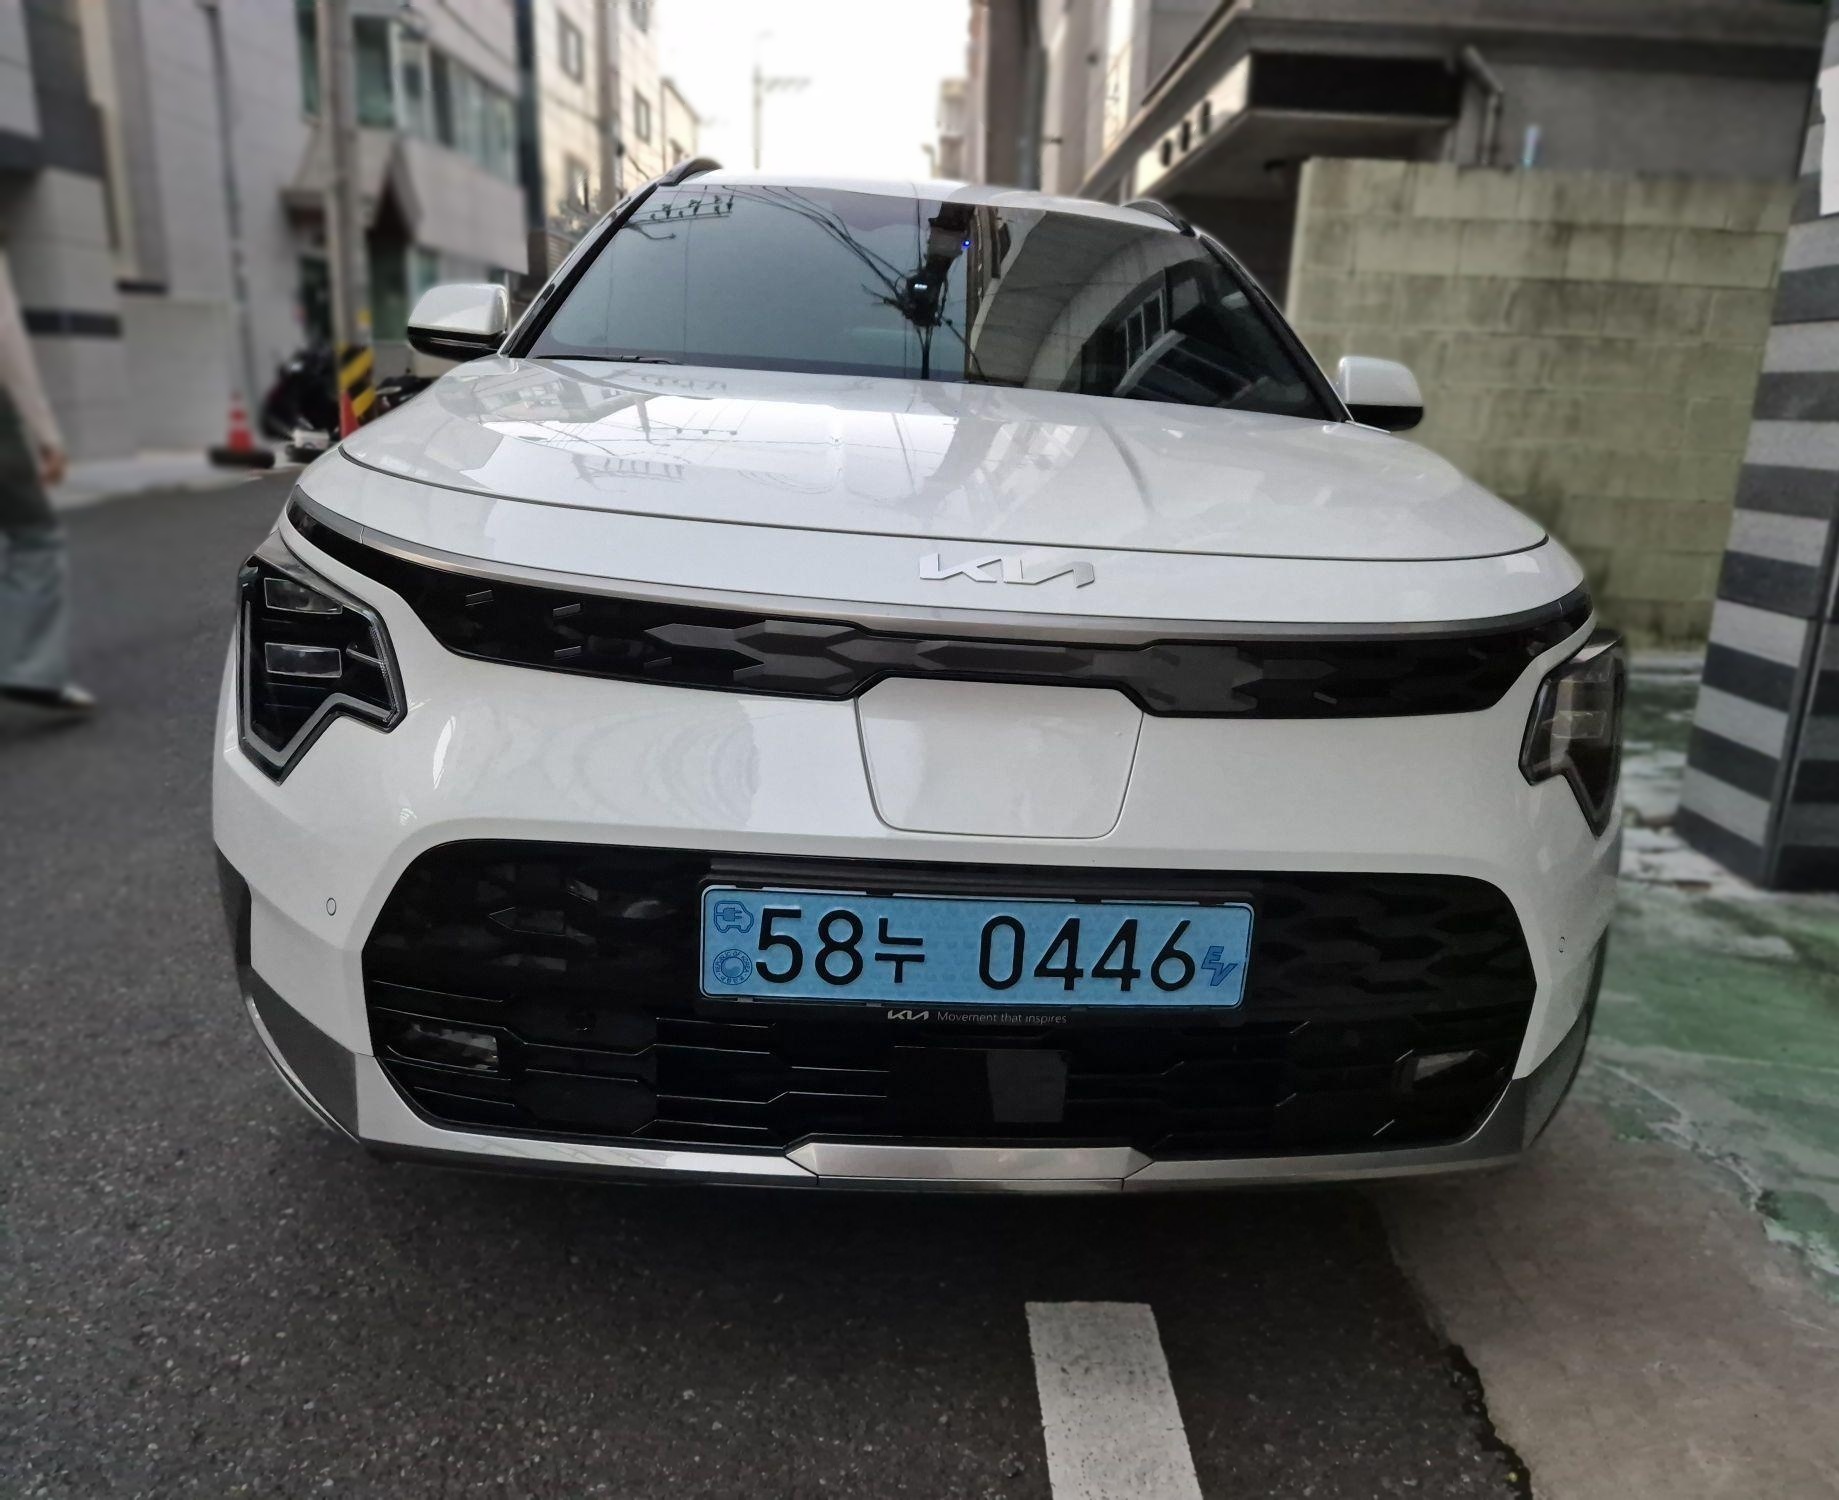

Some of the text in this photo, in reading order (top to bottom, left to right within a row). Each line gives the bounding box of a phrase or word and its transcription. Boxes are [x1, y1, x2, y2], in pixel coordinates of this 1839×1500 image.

[919, 552, 1096, 589] KIA
[756, 907, 1196, 992] 58누 0446
[1200, 945, 1238, 988] EV
[887, 1009, 1067, 1025] KIA Movement that inspires
